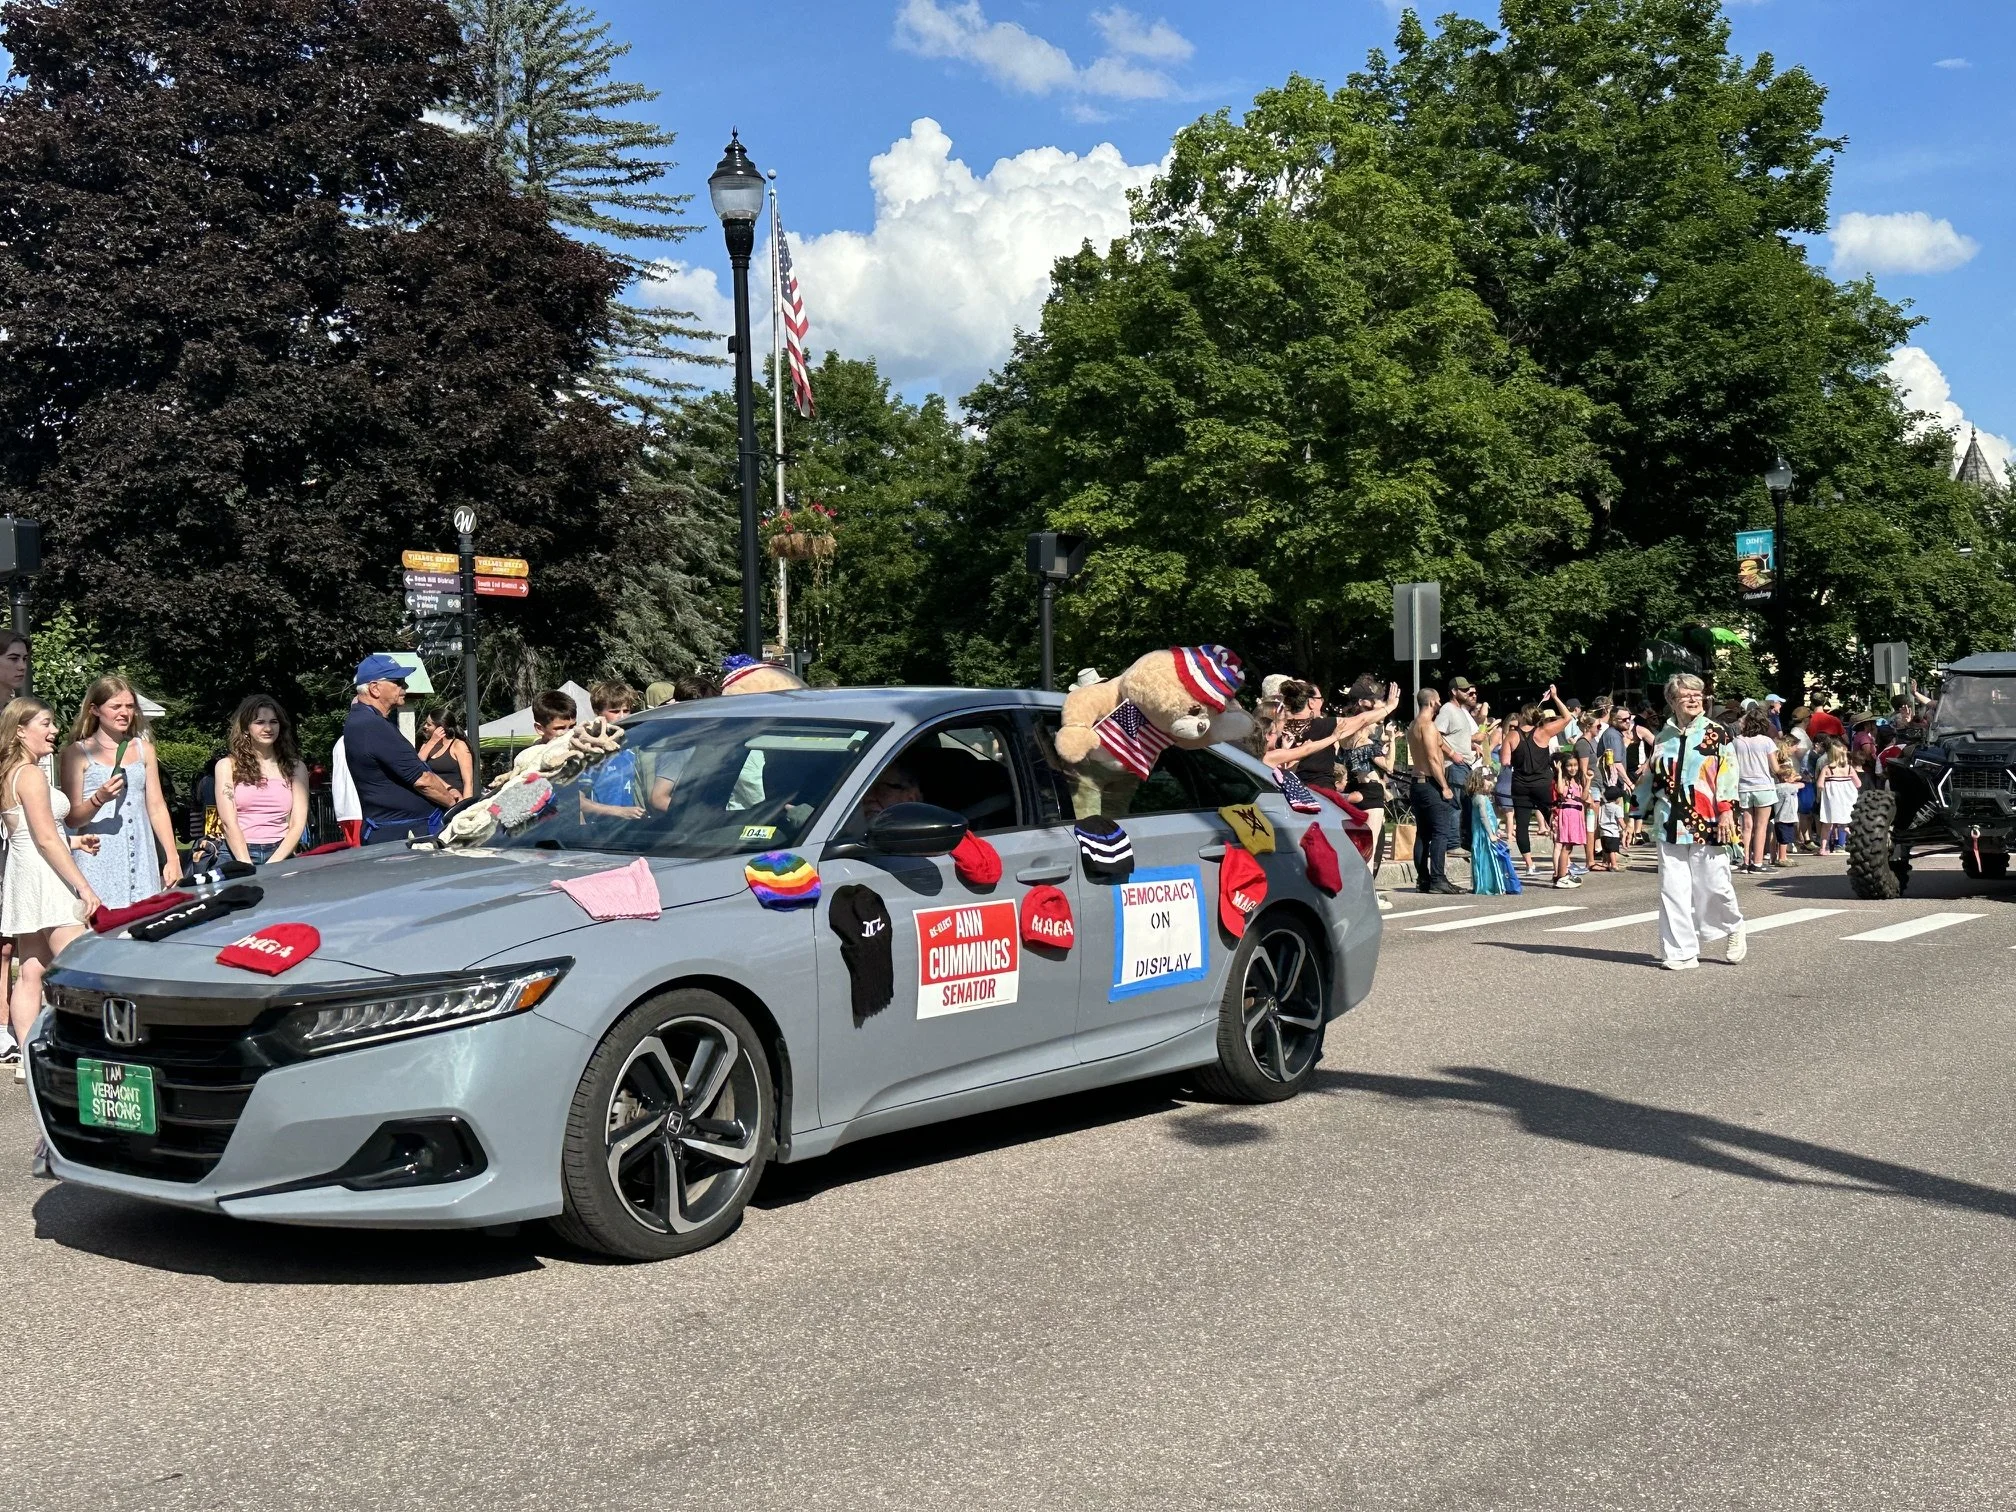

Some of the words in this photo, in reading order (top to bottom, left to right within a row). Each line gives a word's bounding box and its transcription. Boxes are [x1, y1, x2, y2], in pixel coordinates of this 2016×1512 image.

[623, 780, 632, 794] 4
[1231, 890, 1259, 913] MAG
[955, 909, 983, 939] ANN
[1031, 914, 1075, 938] MAGA
[1151, 911, 1171, 930] ON
[928, 938, 1011, 980] CUMMINGS
[1135, 952, 1193, 978] DISPLAY
[942, 978, 997, 1007] SENATOR
[110, 1065, 122, 1081] AM
[91, 1081, 140, 1103] VERMONT
[92, 1097, 142, 1121] STRONG
